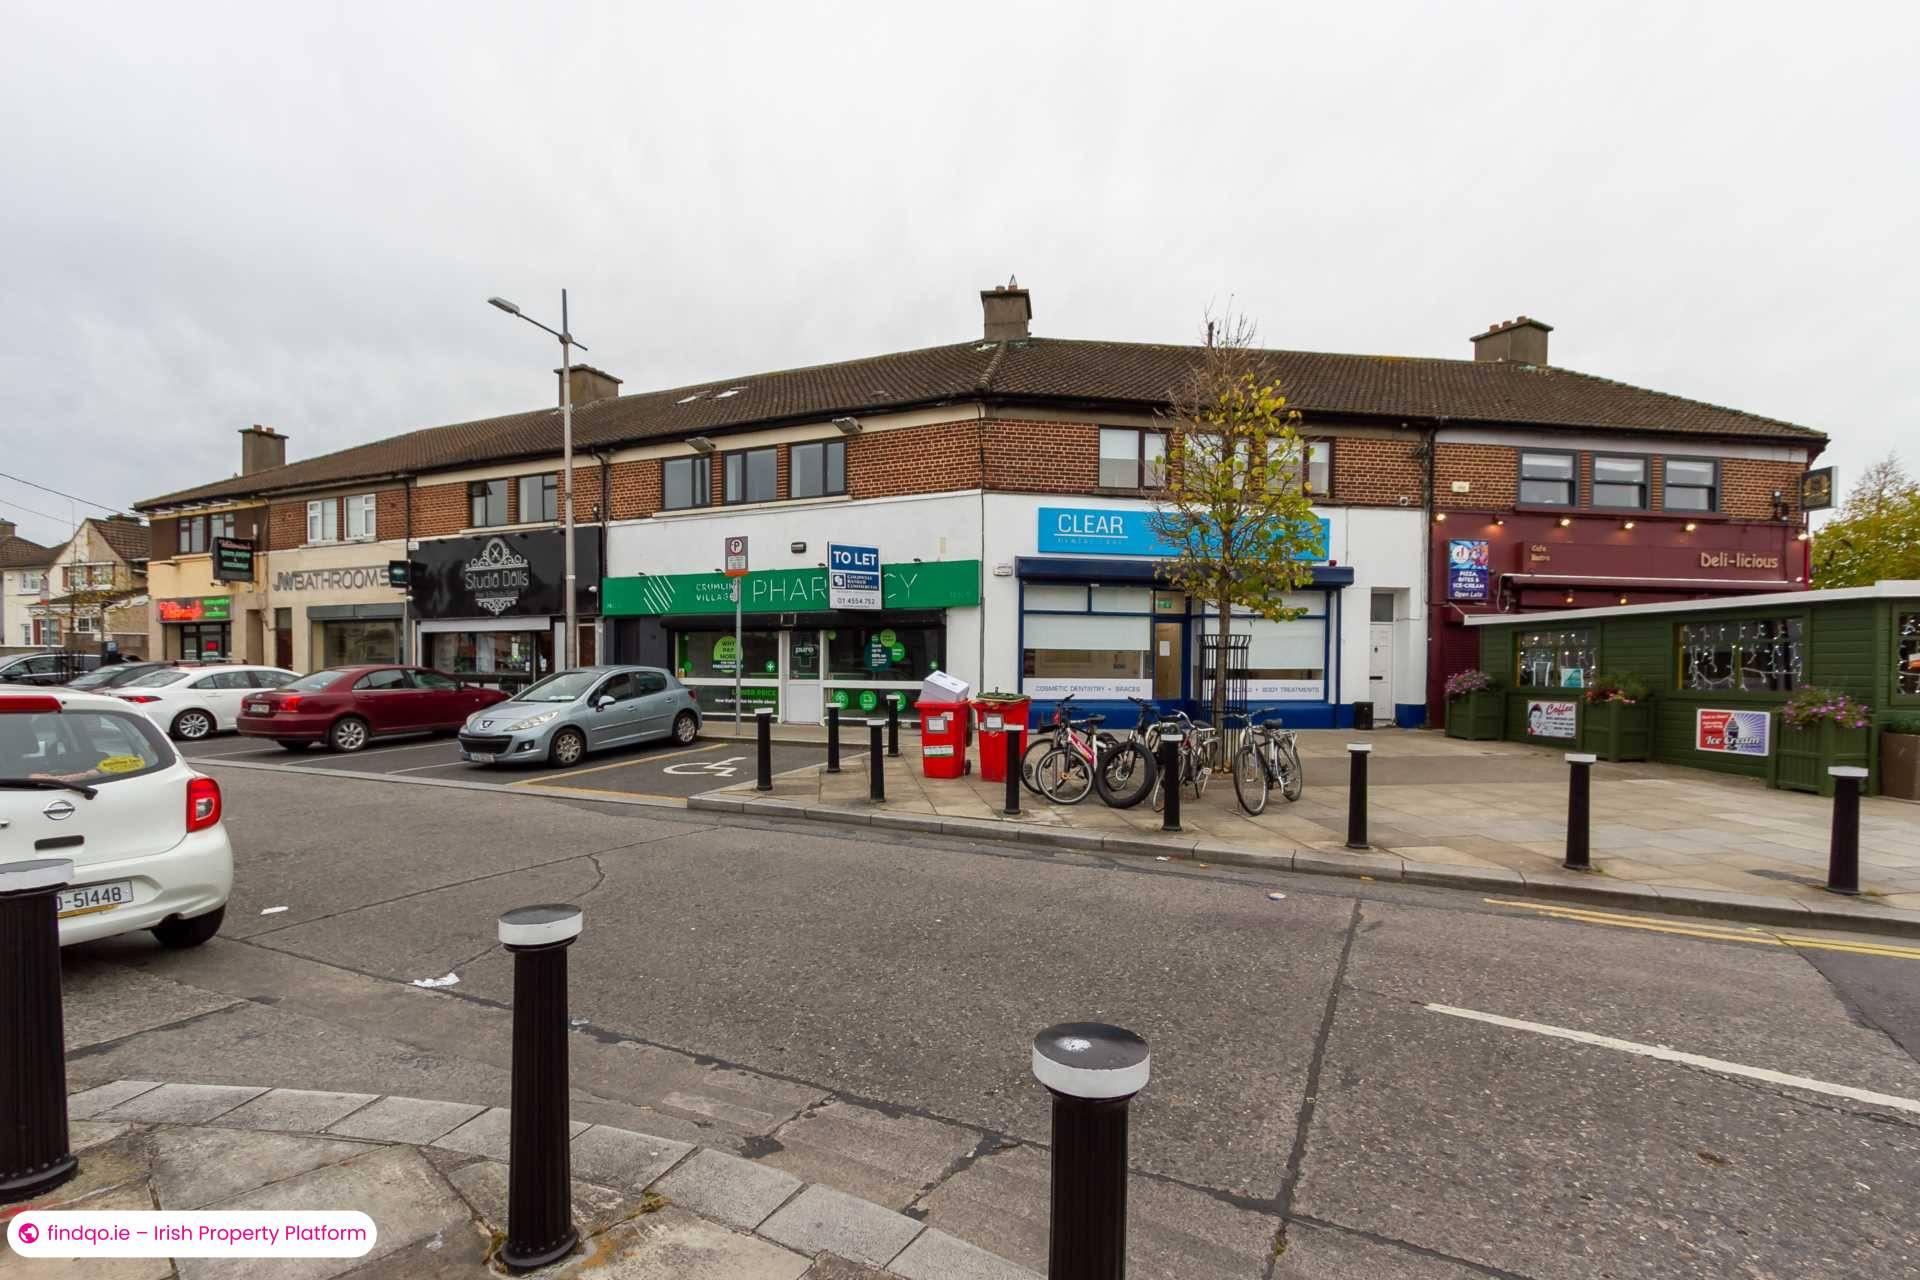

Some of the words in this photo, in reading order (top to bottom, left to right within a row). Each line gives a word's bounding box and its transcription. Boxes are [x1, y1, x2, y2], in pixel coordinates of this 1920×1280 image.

[1058, 513, 1124, 534] CLEAR
[833, 550, 851, 564] TO
[854, 552, 877, 566] LET
[1700, 551, 1779, 568] Deli-licious
[465, 571, 500, 590] Studio
[502, 569, 529, 587] Dolls
